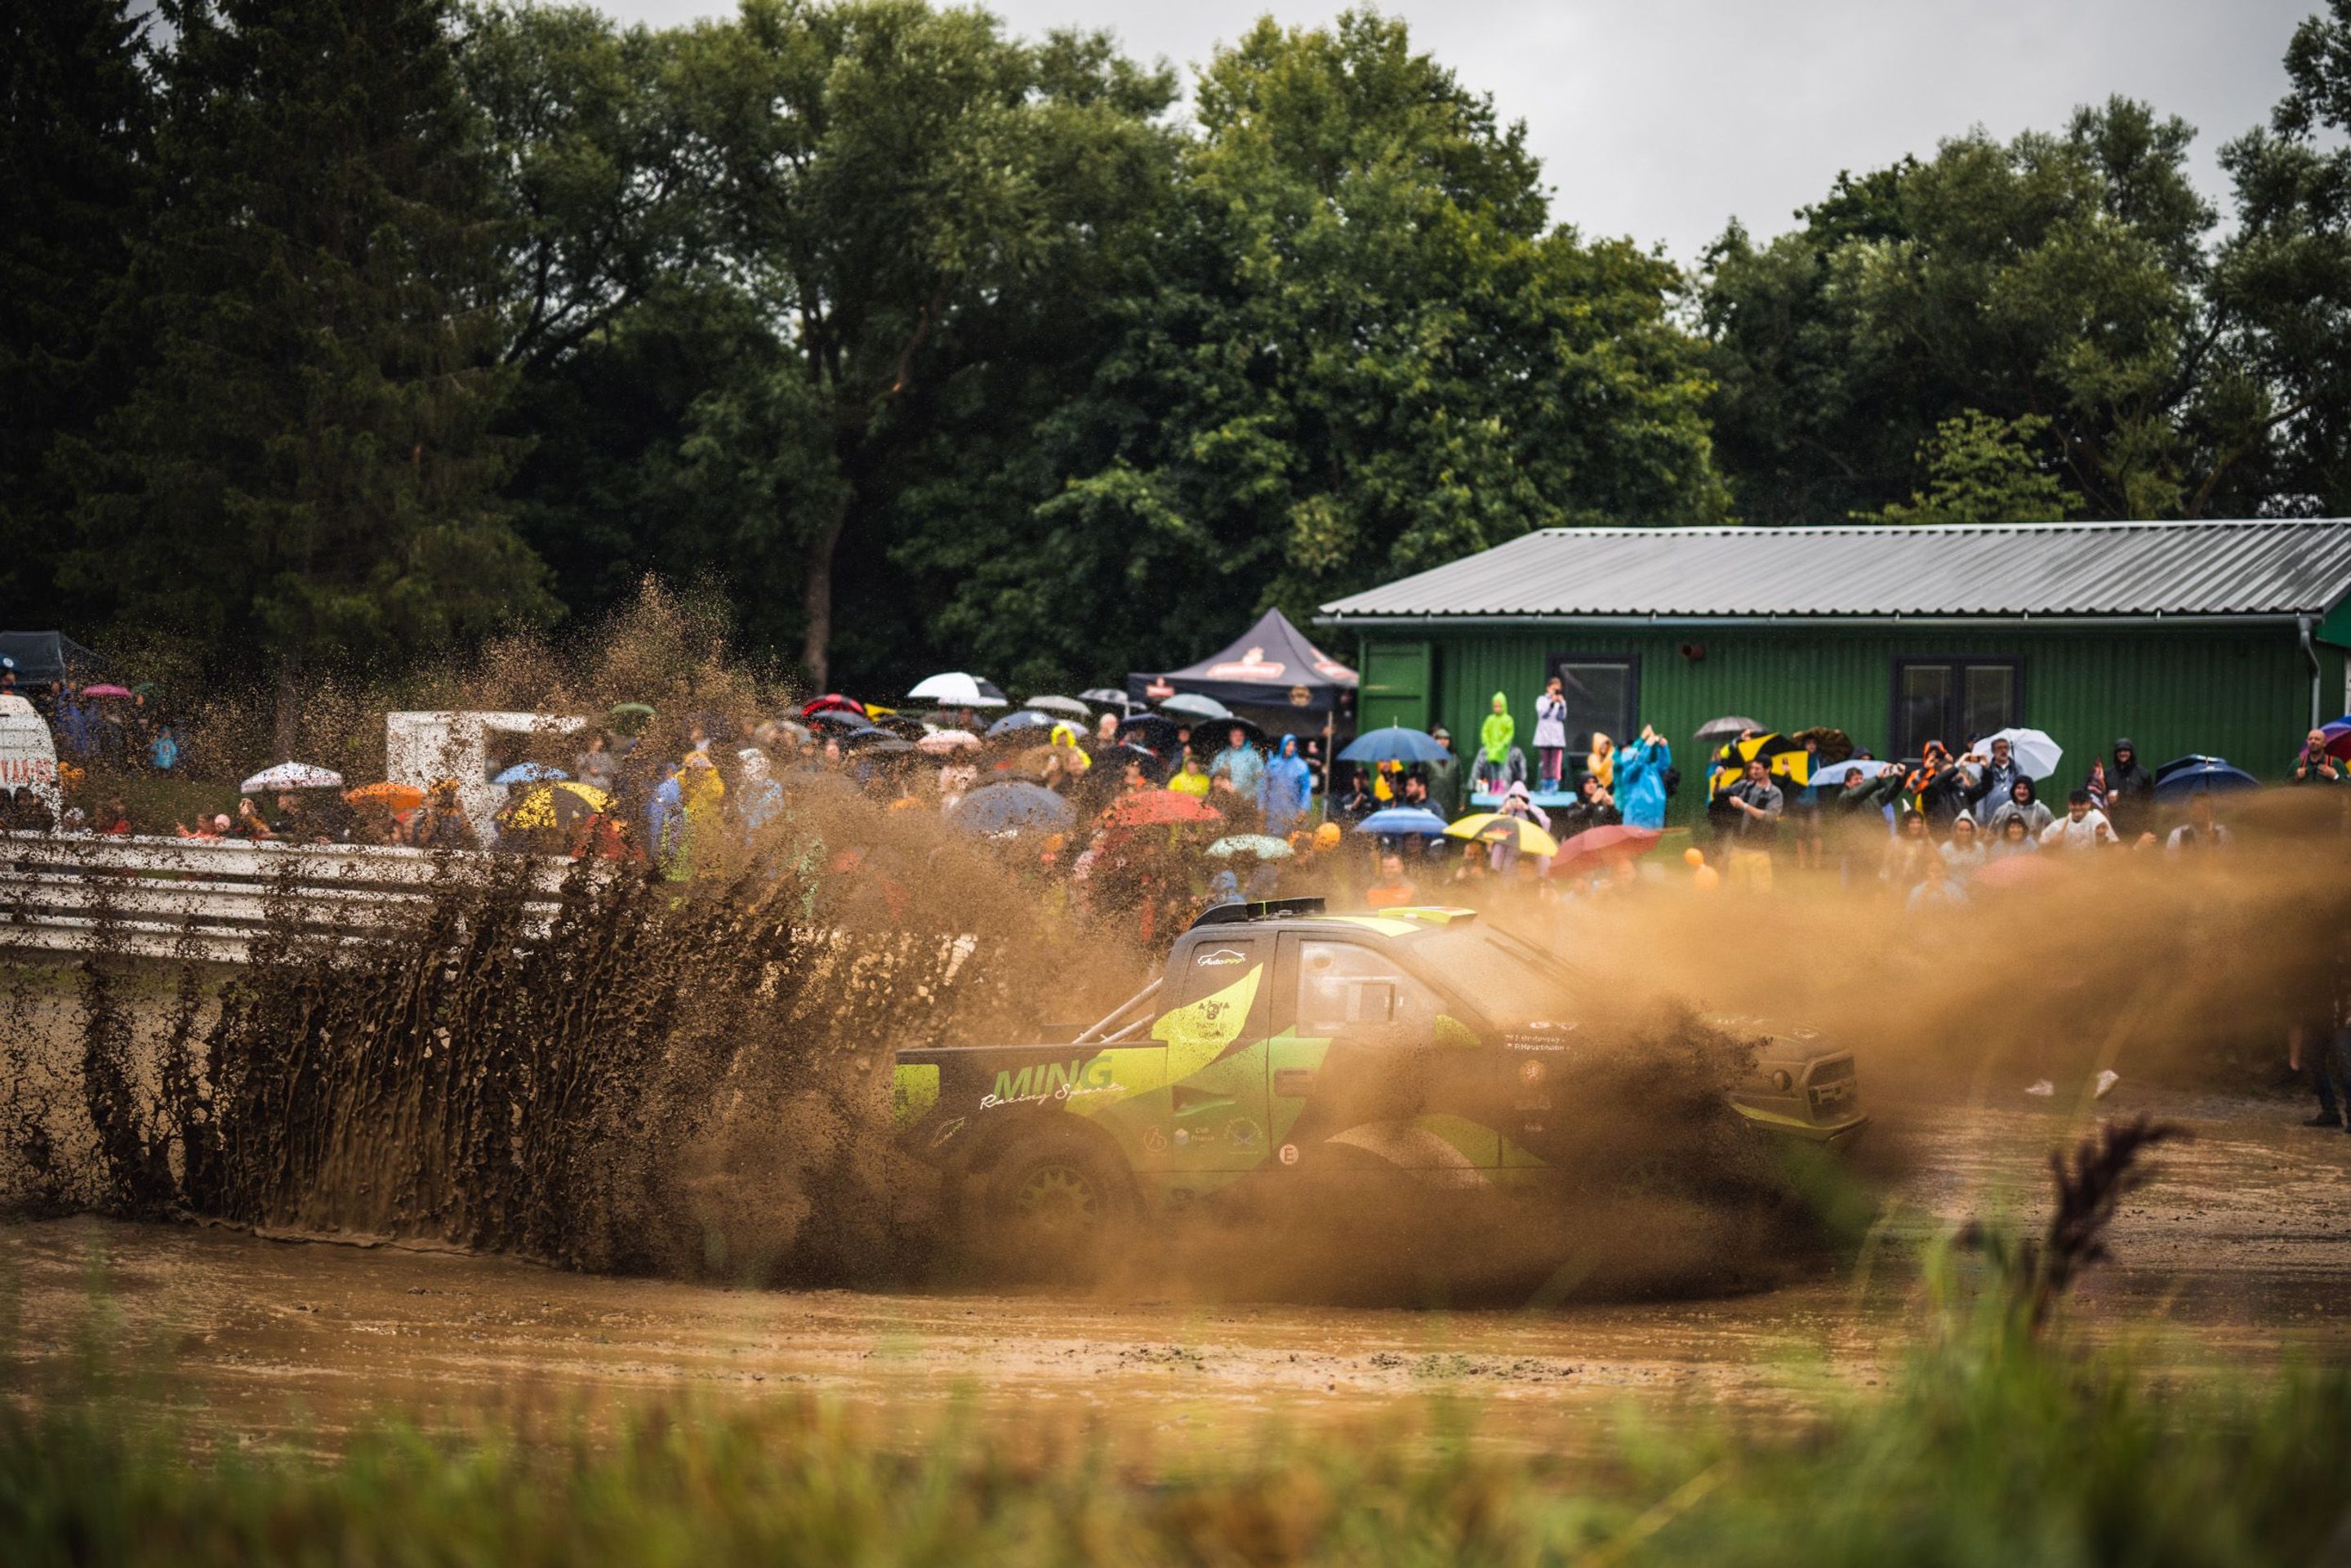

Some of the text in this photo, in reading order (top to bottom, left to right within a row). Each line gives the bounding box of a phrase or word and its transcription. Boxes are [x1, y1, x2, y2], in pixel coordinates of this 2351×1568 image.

[992, 1055, 1113, 1102] MING
[980, 1082, 1130, 1110] Racing Sports
[1285, 1147, 1294, 1162] E
